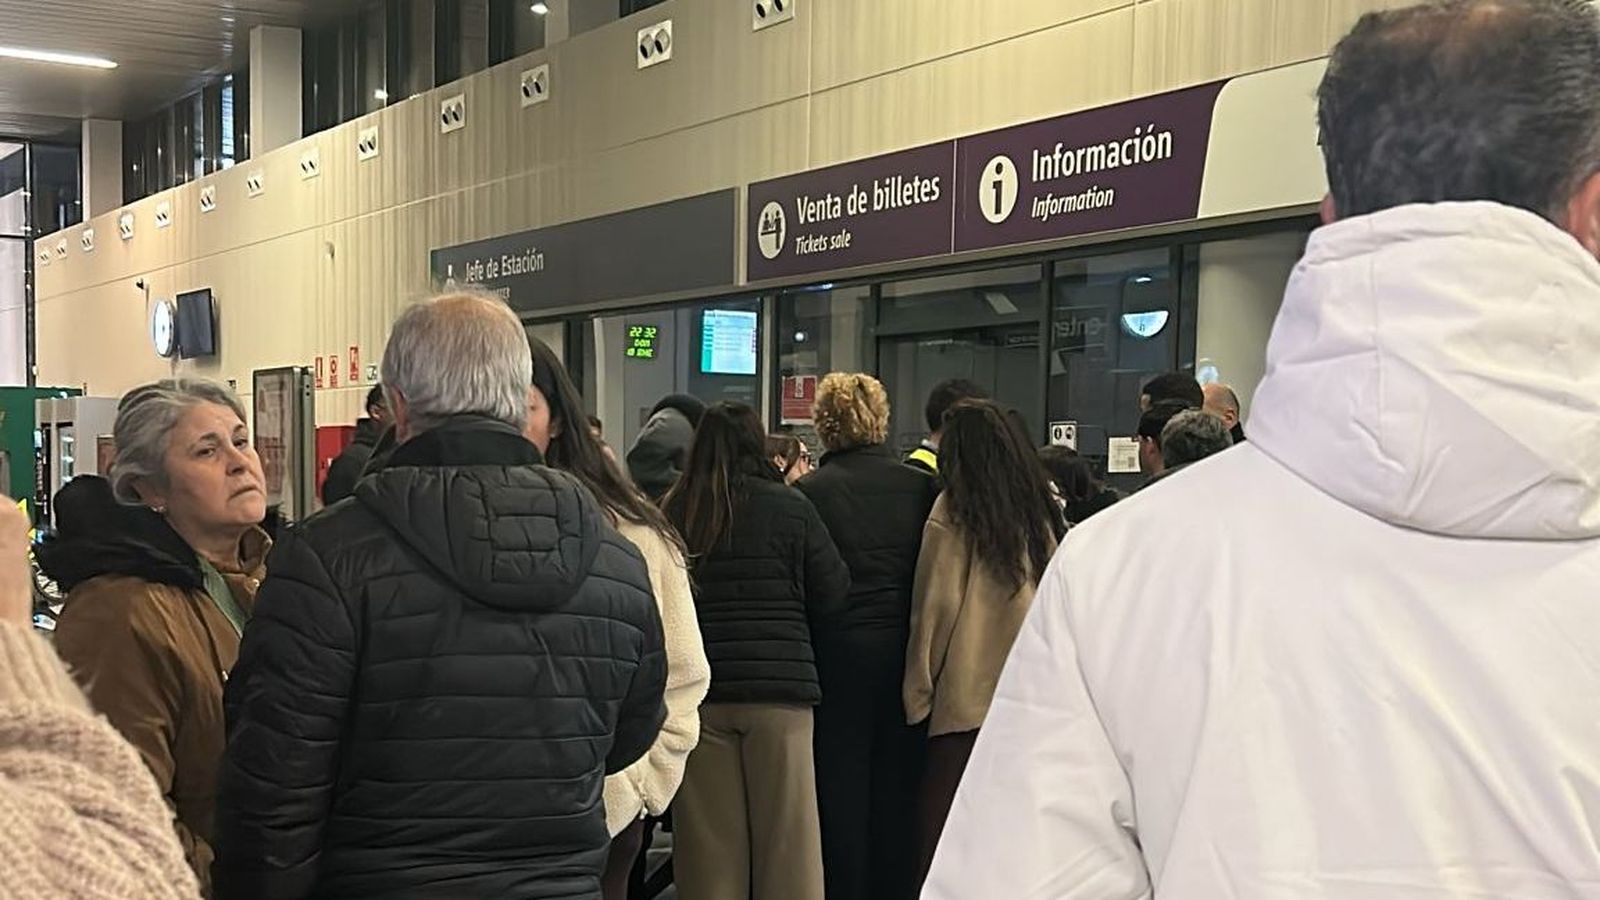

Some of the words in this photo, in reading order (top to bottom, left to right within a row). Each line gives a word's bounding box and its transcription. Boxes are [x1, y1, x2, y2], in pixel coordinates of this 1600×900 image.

[1031, 124, 1173, 183] Información
[797, 192, 842, 225] Venta
[847, 184, 868, 216] de
[873, 174, 940, 209] billetes
[1031, 185, 1115, 220] Information
[795, 235, 828, 255] Tickets
[830, 228, 851, 250] sale
[465, 260, 485, 282] Jefe
[486, 258, 499, 278] de
[501, 248, 544, 275] Estación
[629, 326, 643, 337] 22
[644, 327, 657, 338] 32
